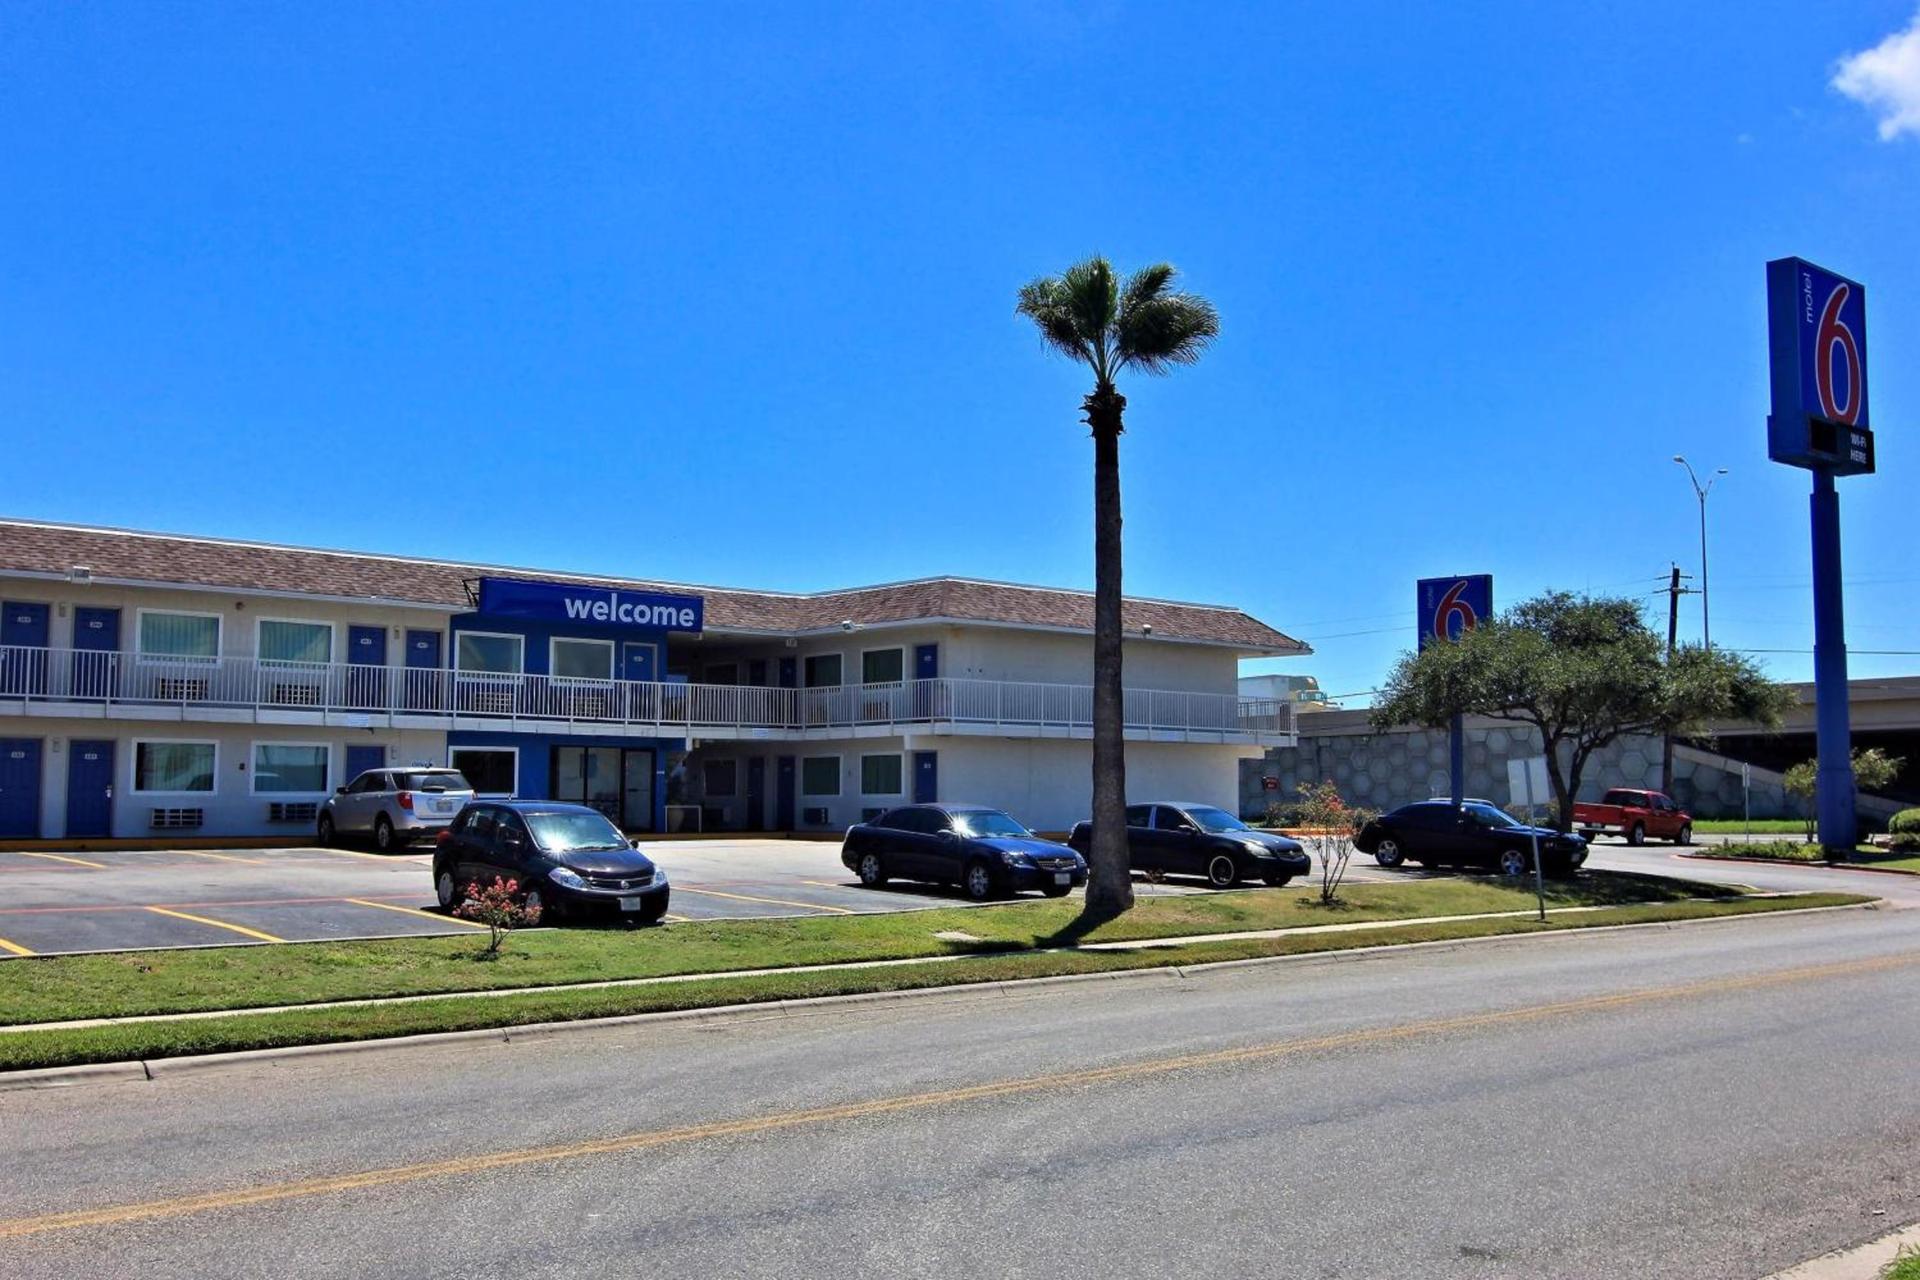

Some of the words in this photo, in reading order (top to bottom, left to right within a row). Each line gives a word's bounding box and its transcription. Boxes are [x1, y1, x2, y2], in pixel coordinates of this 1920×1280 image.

[1803, 271, 1815, 324] motel
[1814, 281, 1861, 426] 6
[563, 592, 695, 627] welcome
[1434, 580, 1476, 644] 6
